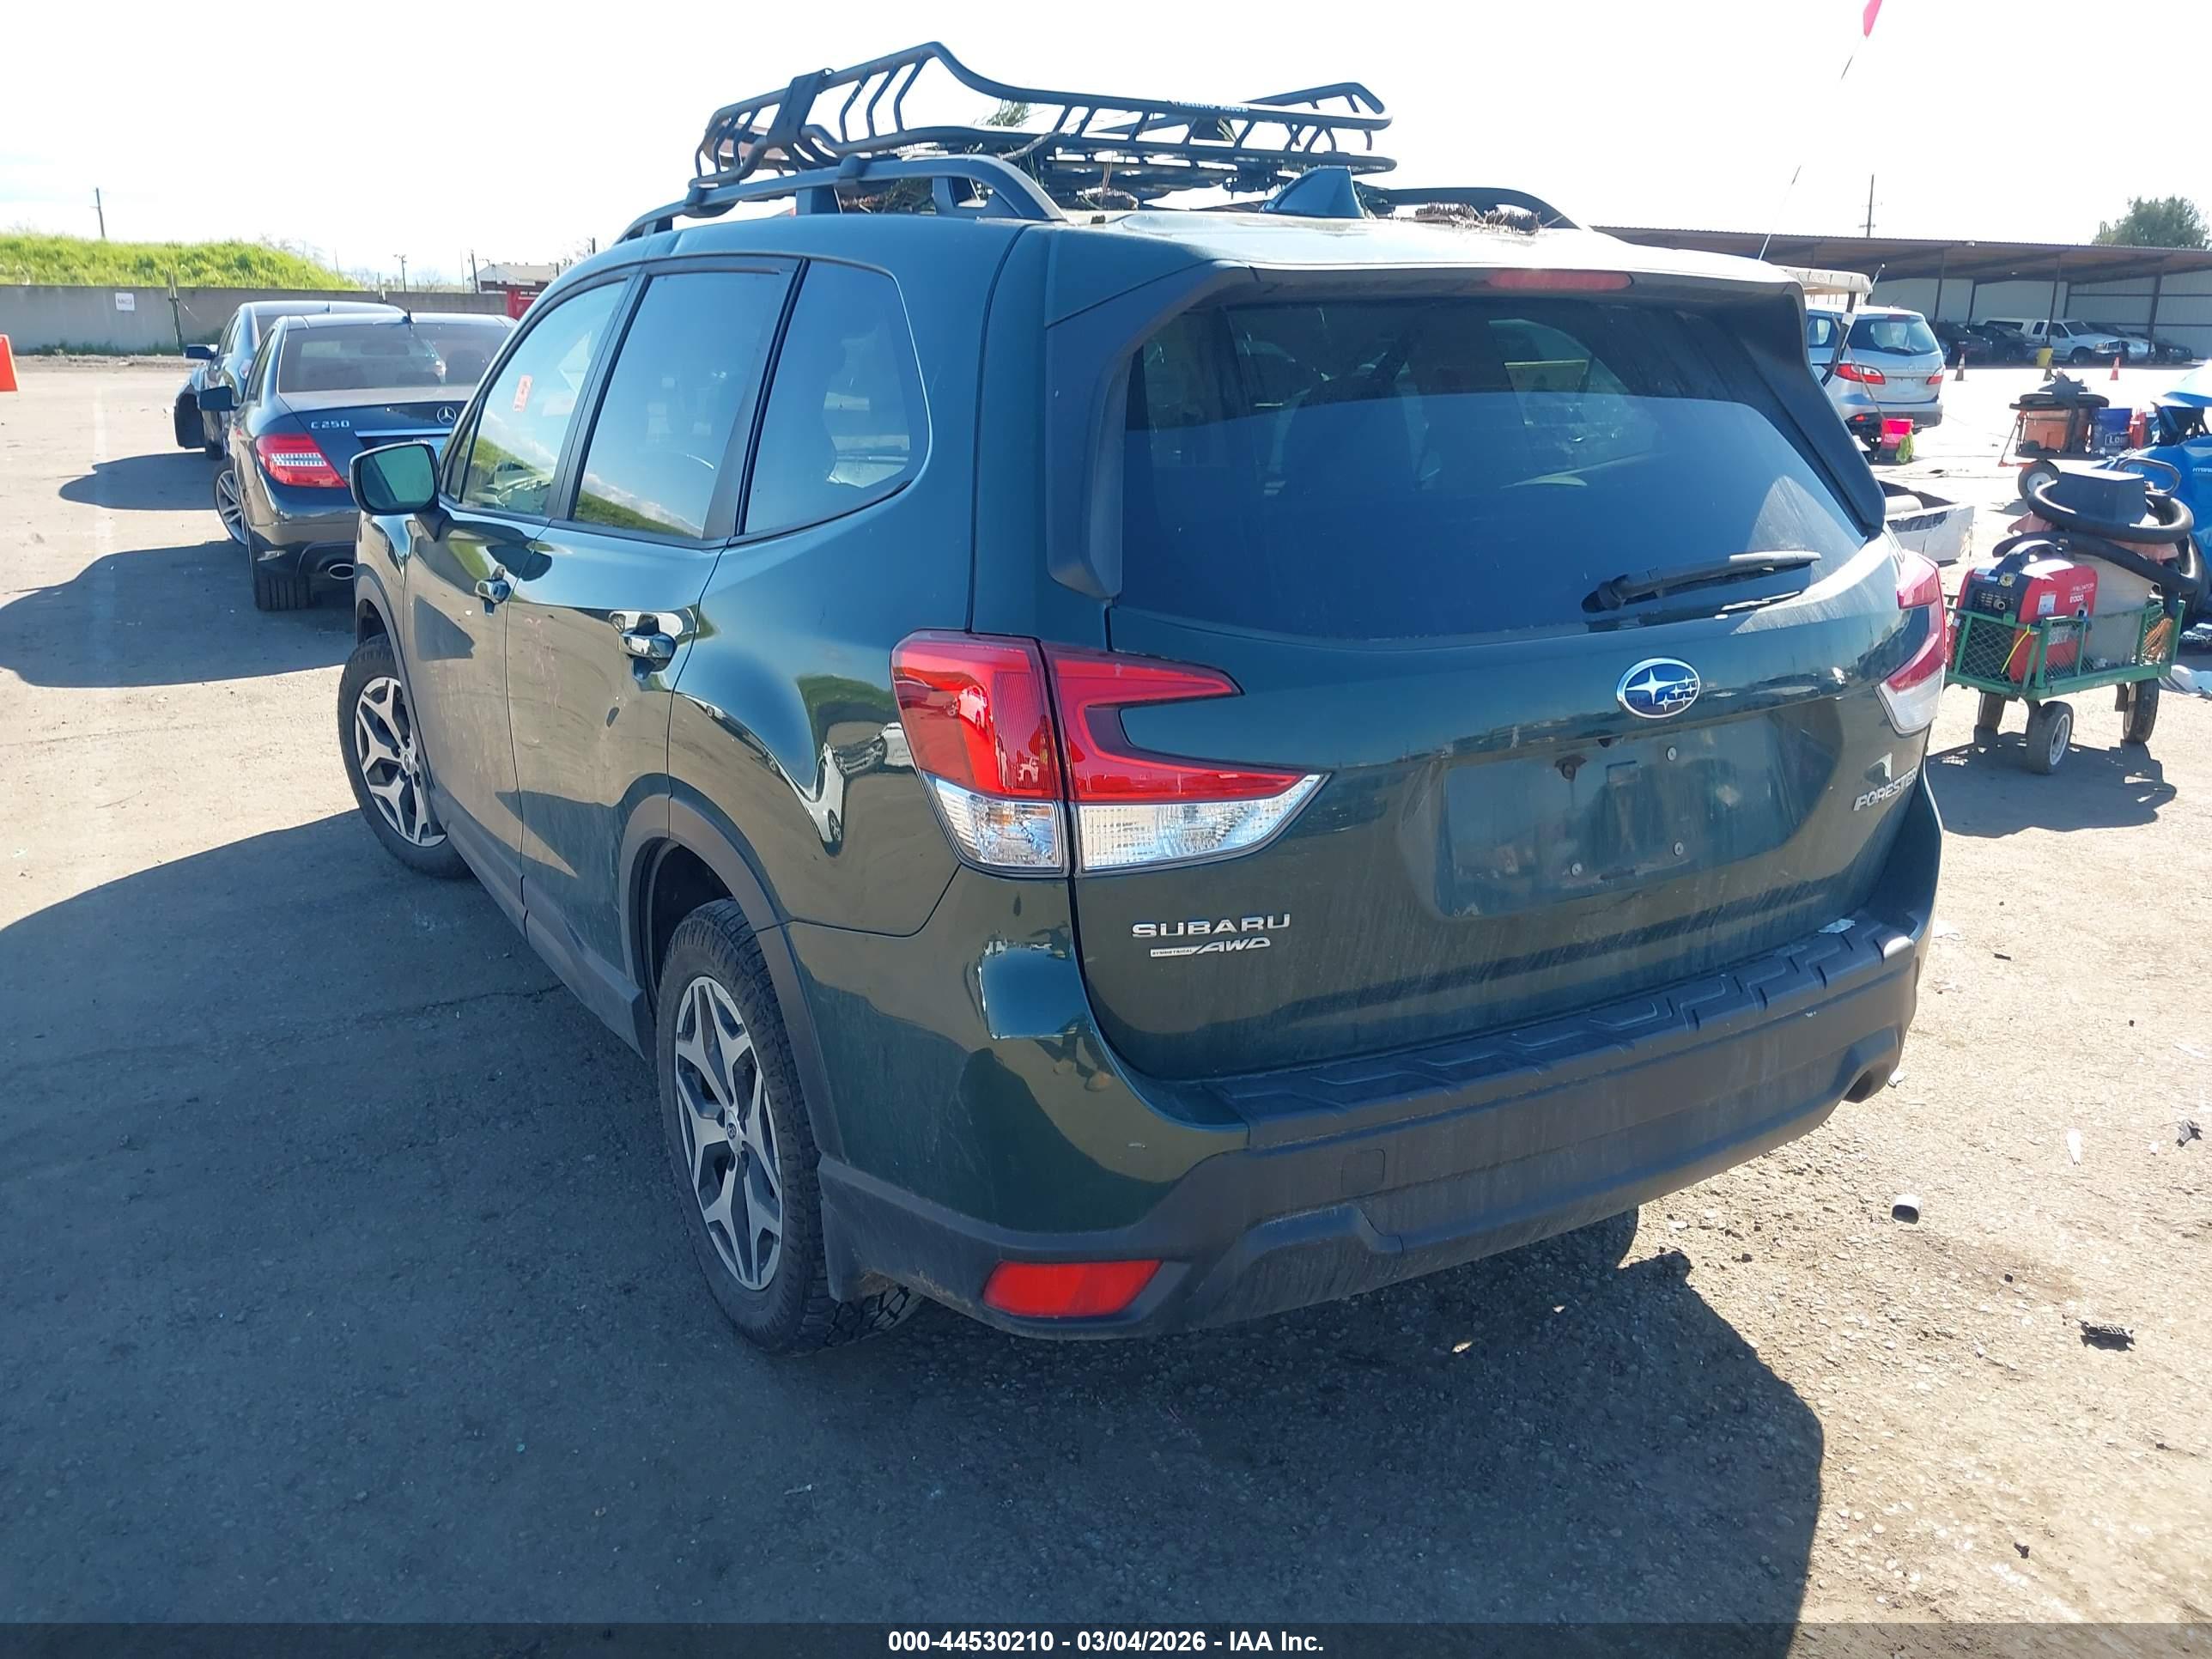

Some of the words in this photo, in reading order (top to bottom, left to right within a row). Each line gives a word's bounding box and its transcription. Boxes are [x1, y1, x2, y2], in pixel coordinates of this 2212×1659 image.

[321, 420, 349, 428] 250
[1853, 767, 1918, 811] FORESTER
[1132, 913, 1291, 938] SUBARU
[1196, 937, 1271, 955] AWD
